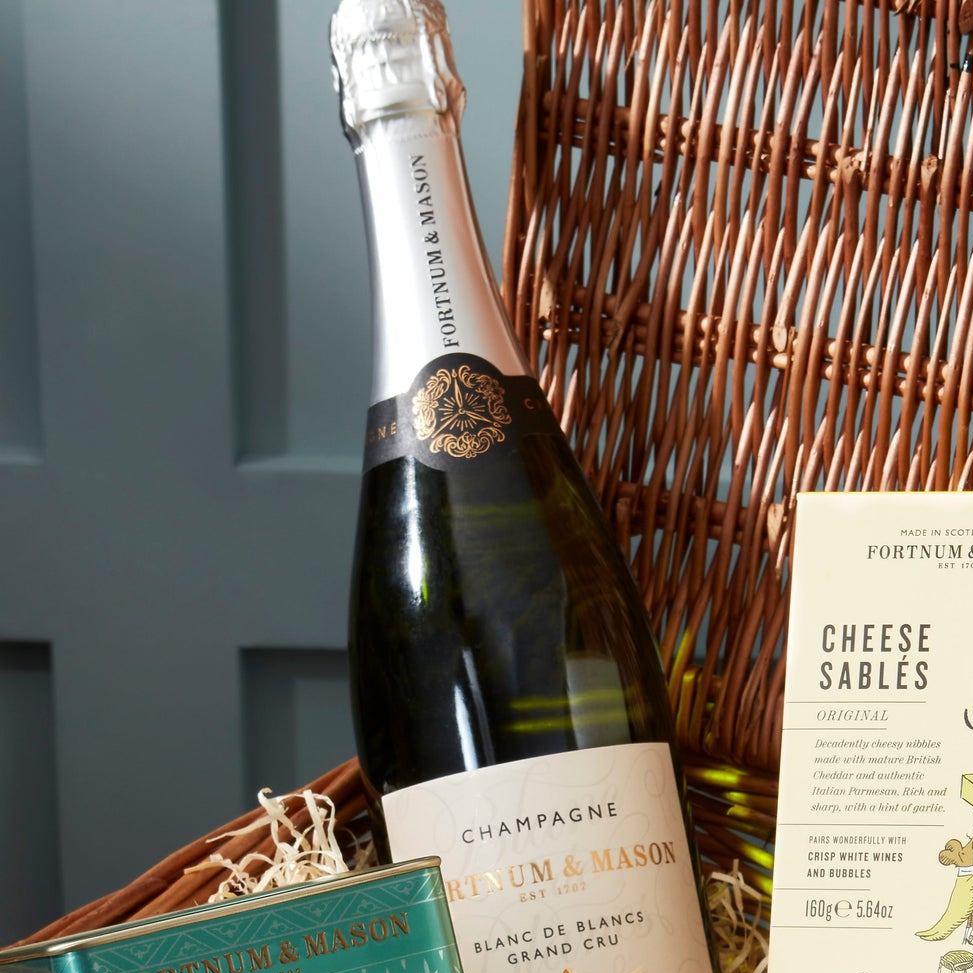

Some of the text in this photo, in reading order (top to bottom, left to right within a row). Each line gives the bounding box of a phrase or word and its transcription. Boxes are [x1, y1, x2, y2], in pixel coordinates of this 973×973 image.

[411, 154, 459, 348] FORTNUM & MASON
[901, 529, 927, 537] MADE
[931, 529, 942, 537] IN
[867, 545, 963, 560] FORTNUM
[821, 624, 931, 653] CHEESE
[819, 655, 929, 690] SABLÉS
[816, 710, 889, 722] ORIGINAL
[815, 739, 941, 751] Decadently cheesy nibbles
[814, 756, 942, 765] made with mature British
[812, 771, 925, 780] Cheddar and authentic
[811, 787, 947, 797] Italian Parmesan. Rich and
[810, 803, 841, 813] sharp,
[844, 804, 867, 812] with
[878, 803, 899, 812] hint
[901, 803, 912, 812] of
[912, 803, 946, 814] garlic.
[462, 802, 618, 844] CHAMPAGNE
[808, 836, 907, 845] PAIRS WONDERFULLY WITH
[807, 853, 903, 862] CRISP WHITE WINES
[447, 841, 677, 902] RTNUM & MASON
[807, 869, 872, 878] AND BUBBLES
[519, 882, 587, 903] EST 1707
[856, 900, 893, 919] 5.64oz
[279, 940, 301, 966] &
[304, 911, 411, 959] MASON
[474, 911, 645, 954] BLANC DE BLANCS
[507, 934, 620, 965] GRAND CRU
